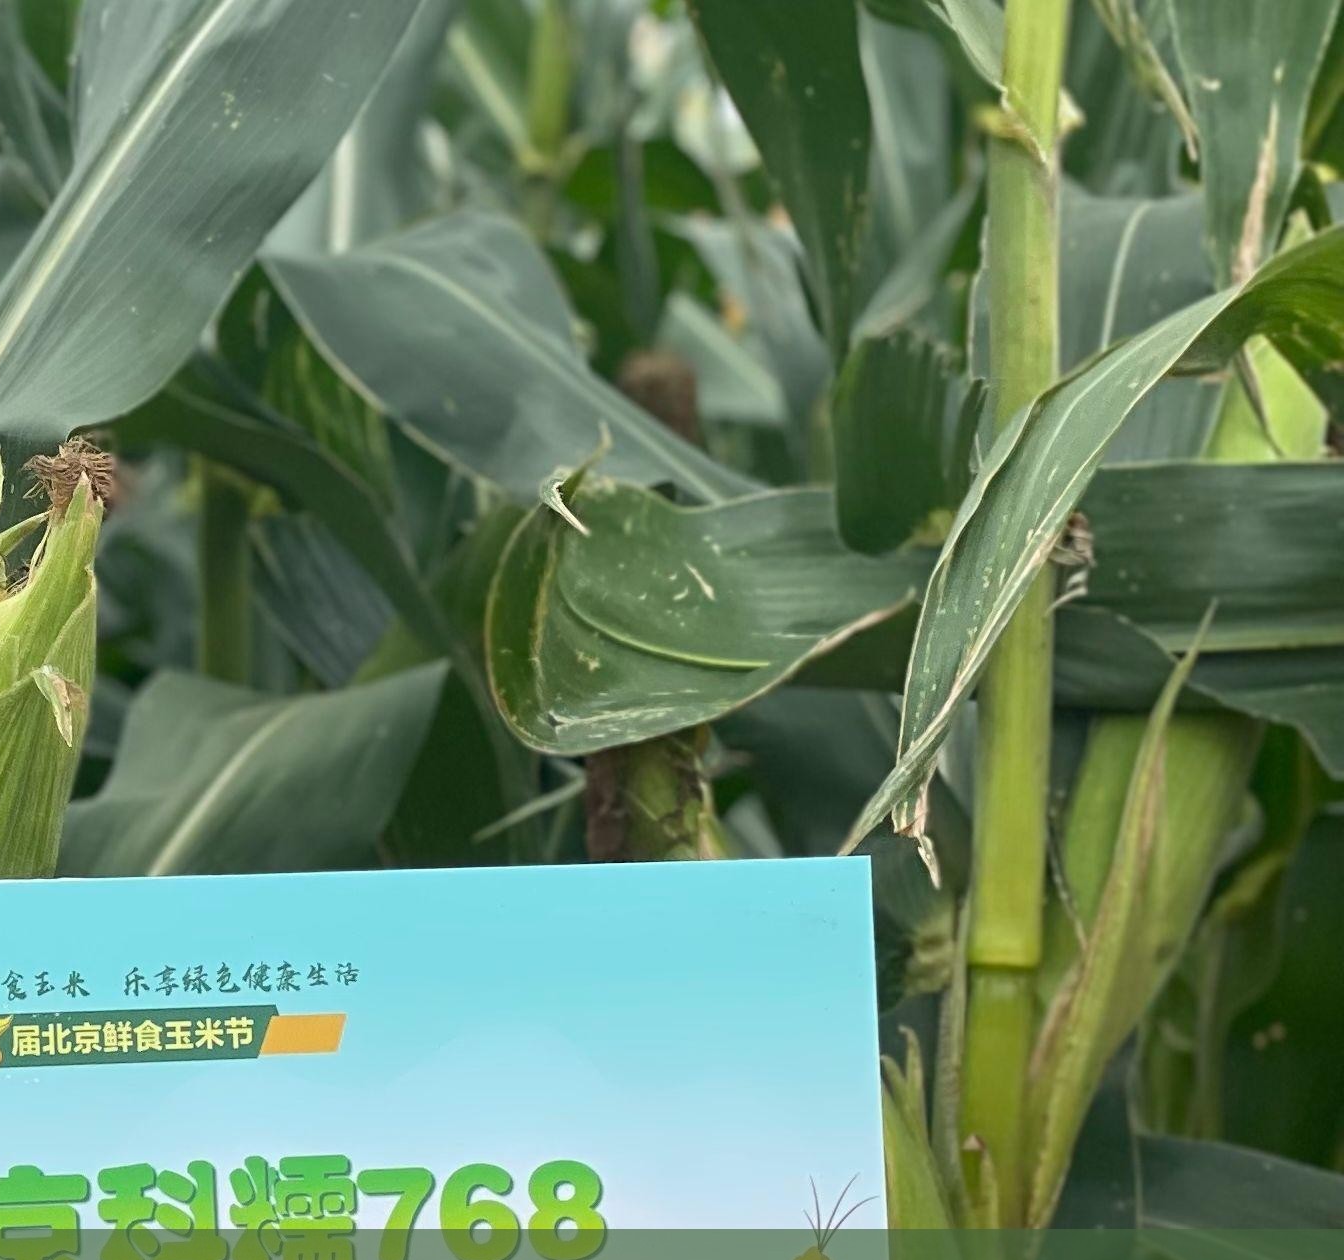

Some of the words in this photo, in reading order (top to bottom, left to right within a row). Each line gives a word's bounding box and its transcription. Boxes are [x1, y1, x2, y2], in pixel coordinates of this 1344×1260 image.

[123, 960, 360, 998] 乐享绿色健康生活
